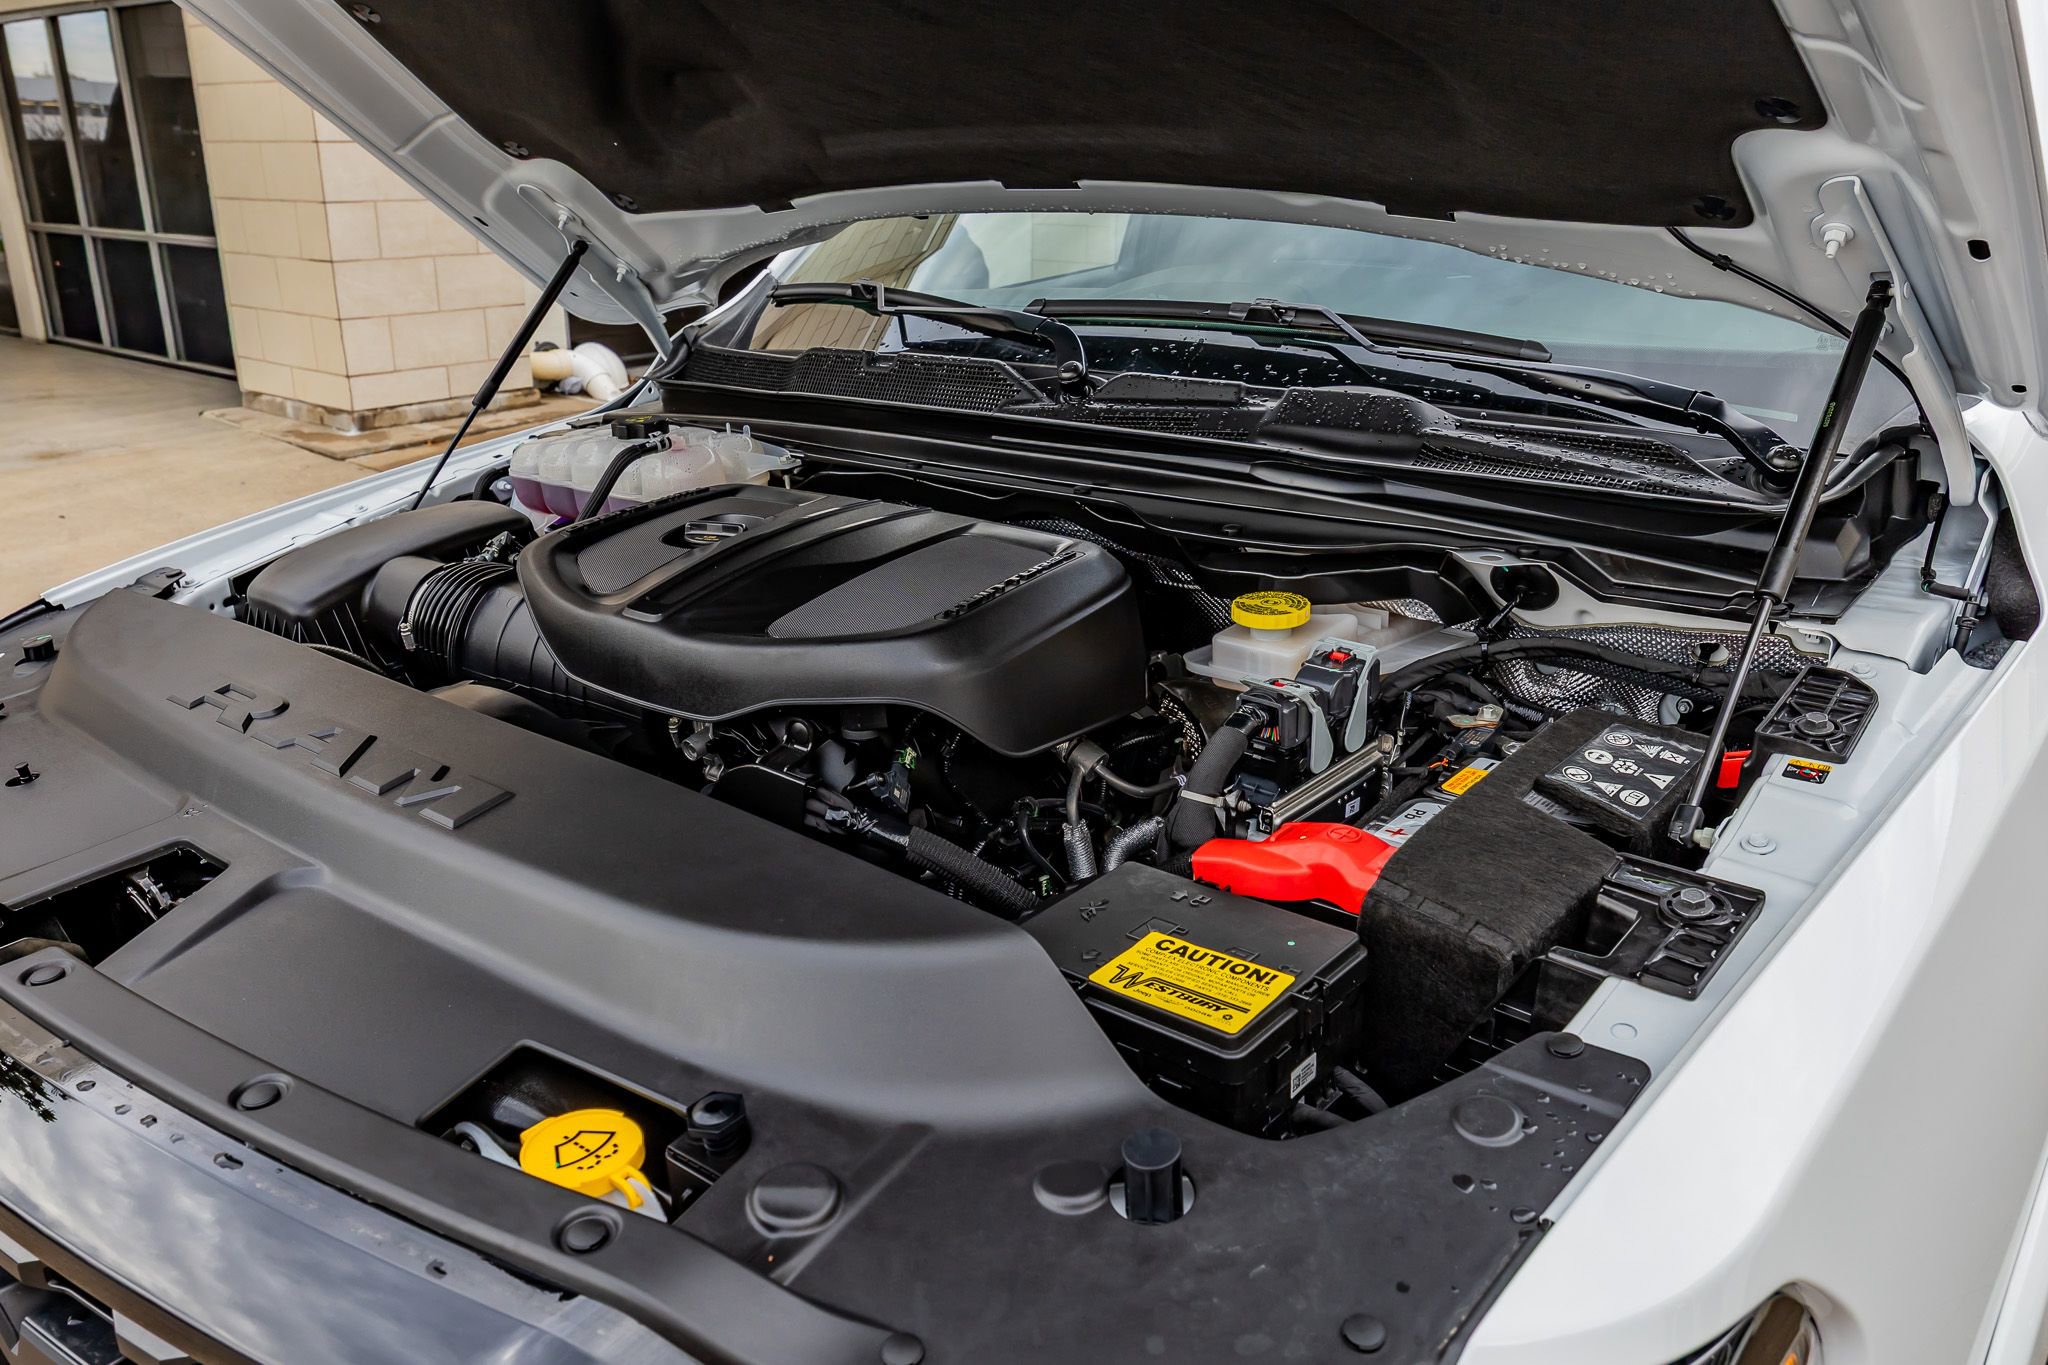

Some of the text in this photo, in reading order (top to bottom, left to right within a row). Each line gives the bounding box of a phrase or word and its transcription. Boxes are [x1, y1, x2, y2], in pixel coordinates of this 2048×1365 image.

[166, 683, 516, 830] RAM
[1404, 808, 1427, 820] Pb
[1155, 939, 1279, 985] CAUTION!
[1220, 972, 1269, 990] COMPONENTS
